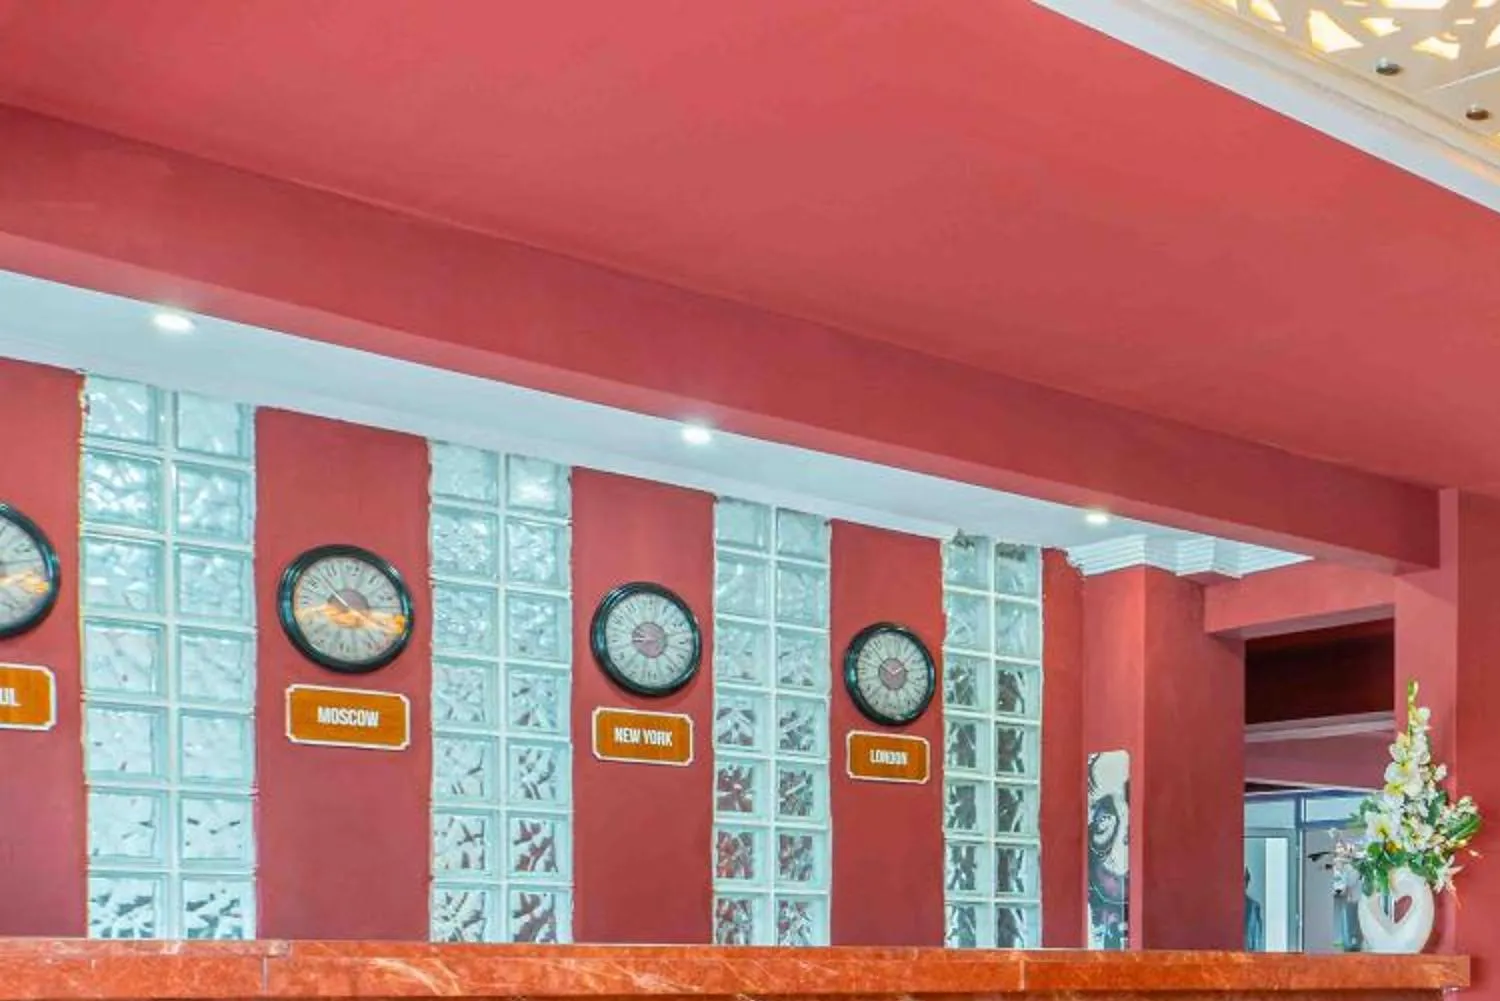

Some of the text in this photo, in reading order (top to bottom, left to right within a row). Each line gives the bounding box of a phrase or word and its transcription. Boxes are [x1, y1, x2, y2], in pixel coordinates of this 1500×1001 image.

[317, 706, 379, 727] MOSCOW
[614, 727, 673, 747] NEW YORK
[869, 749, 908, 766] LONDON
